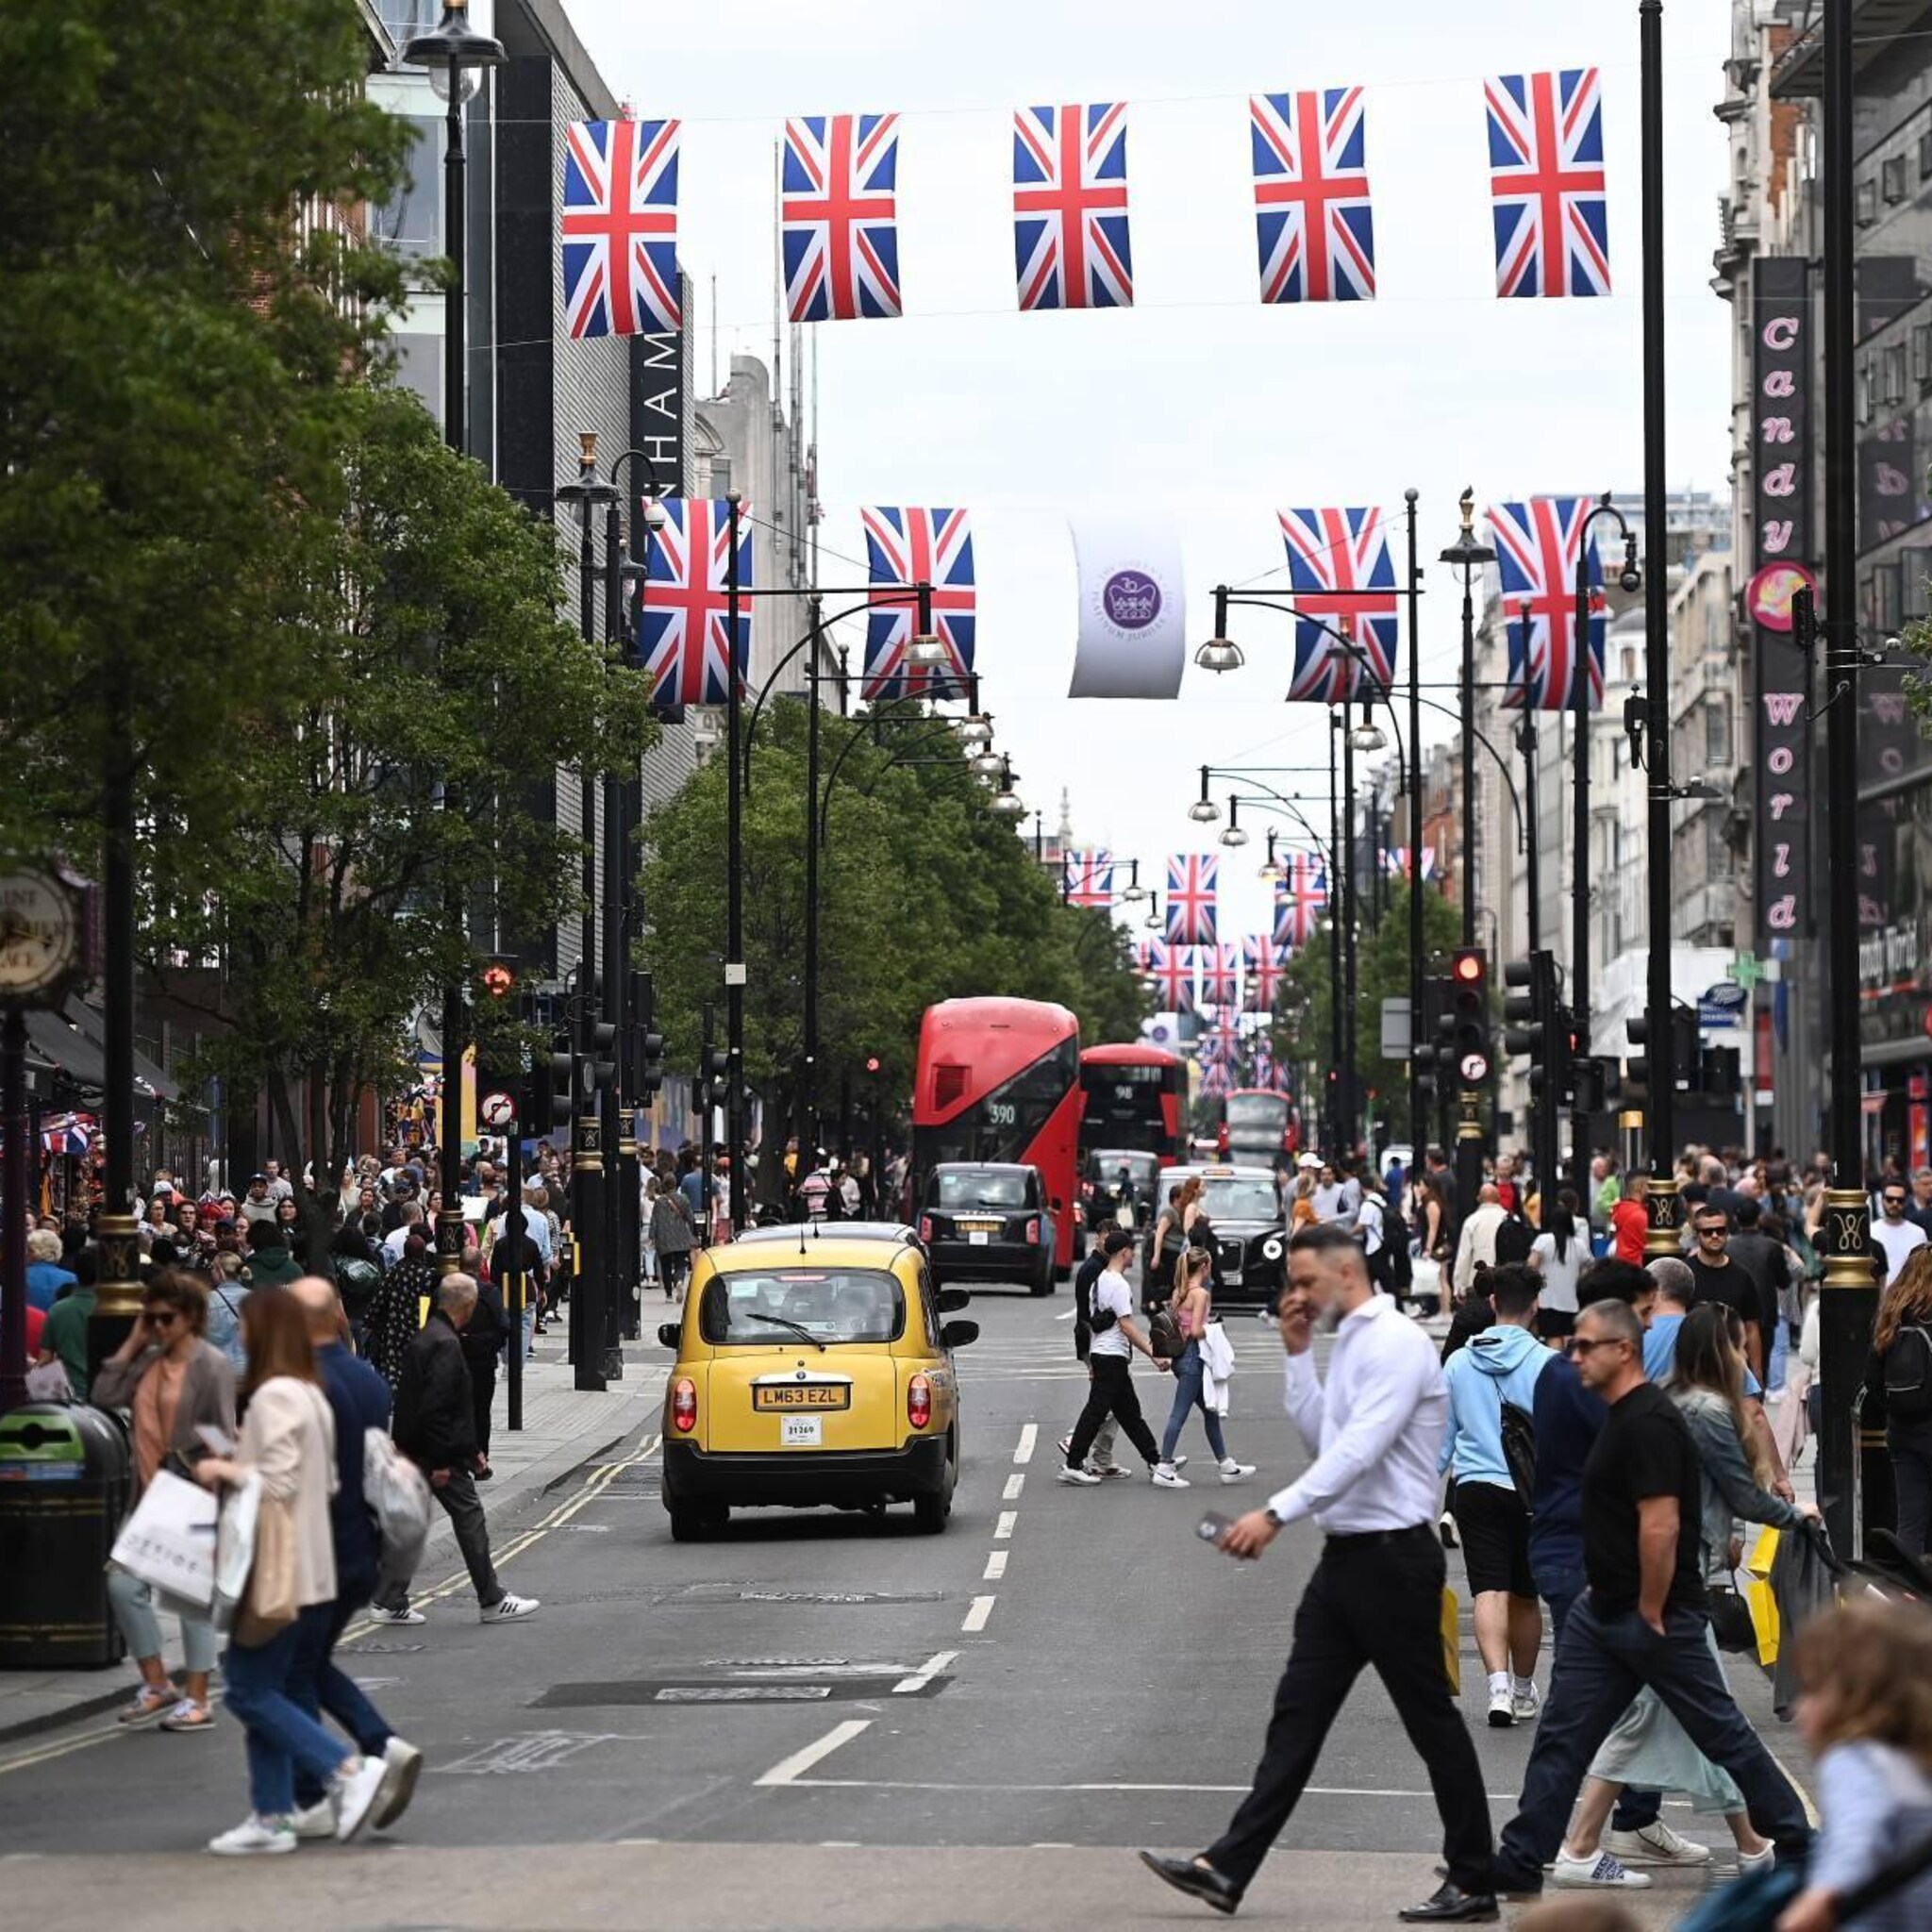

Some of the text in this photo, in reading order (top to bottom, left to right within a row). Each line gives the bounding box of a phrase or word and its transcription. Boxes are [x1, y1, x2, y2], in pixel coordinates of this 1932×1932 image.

[1762, 317, 1804, 929] Candy World
[1115, 1085, 1133, 1100] 98
[989, 1105, 1016, 1124] 390
[763, 1389, 838, 1405] LM63 EZL
